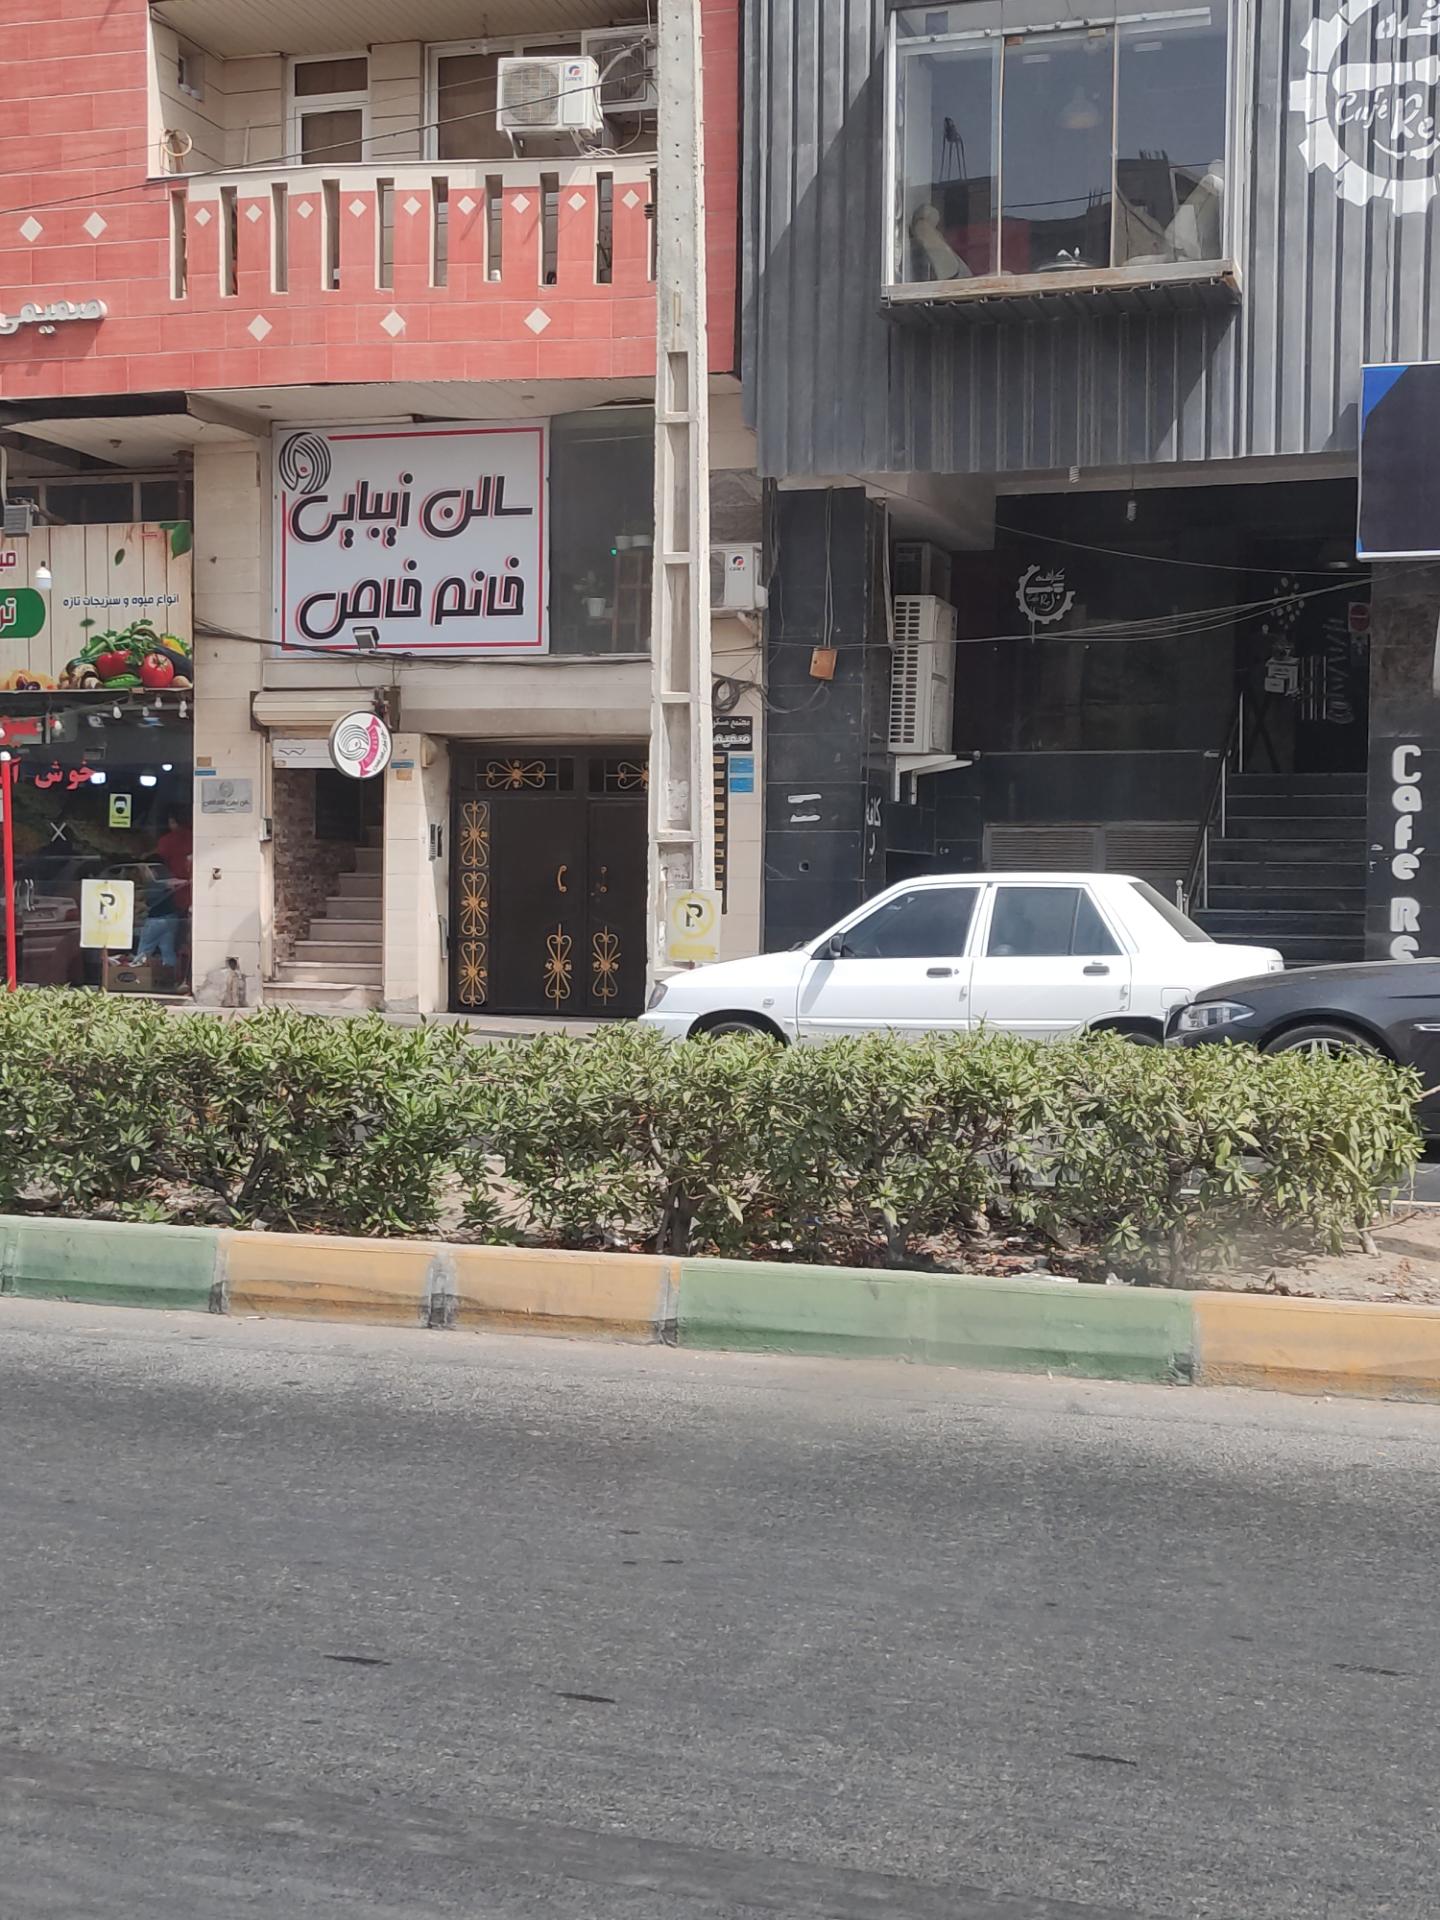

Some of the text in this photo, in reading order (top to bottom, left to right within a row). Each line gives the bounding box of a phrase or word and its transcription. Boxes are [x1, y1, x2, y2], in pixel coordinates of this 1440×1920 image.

[1391, 93, 1440, 141] Re
[290, 473, 413, 549] زیبایی
[62, 595, 81, 610] تازه
[123, 596, 130, 608] و
[131, 595, 154, 608] میوه
[156, 593, 179, 607] انواع
[297, 556, 525, 640] خانم خاص
[35, 760, 97, 790] خوش
[1391, 744, 1425, 881] Café
[685, 903, 704, 928] P
